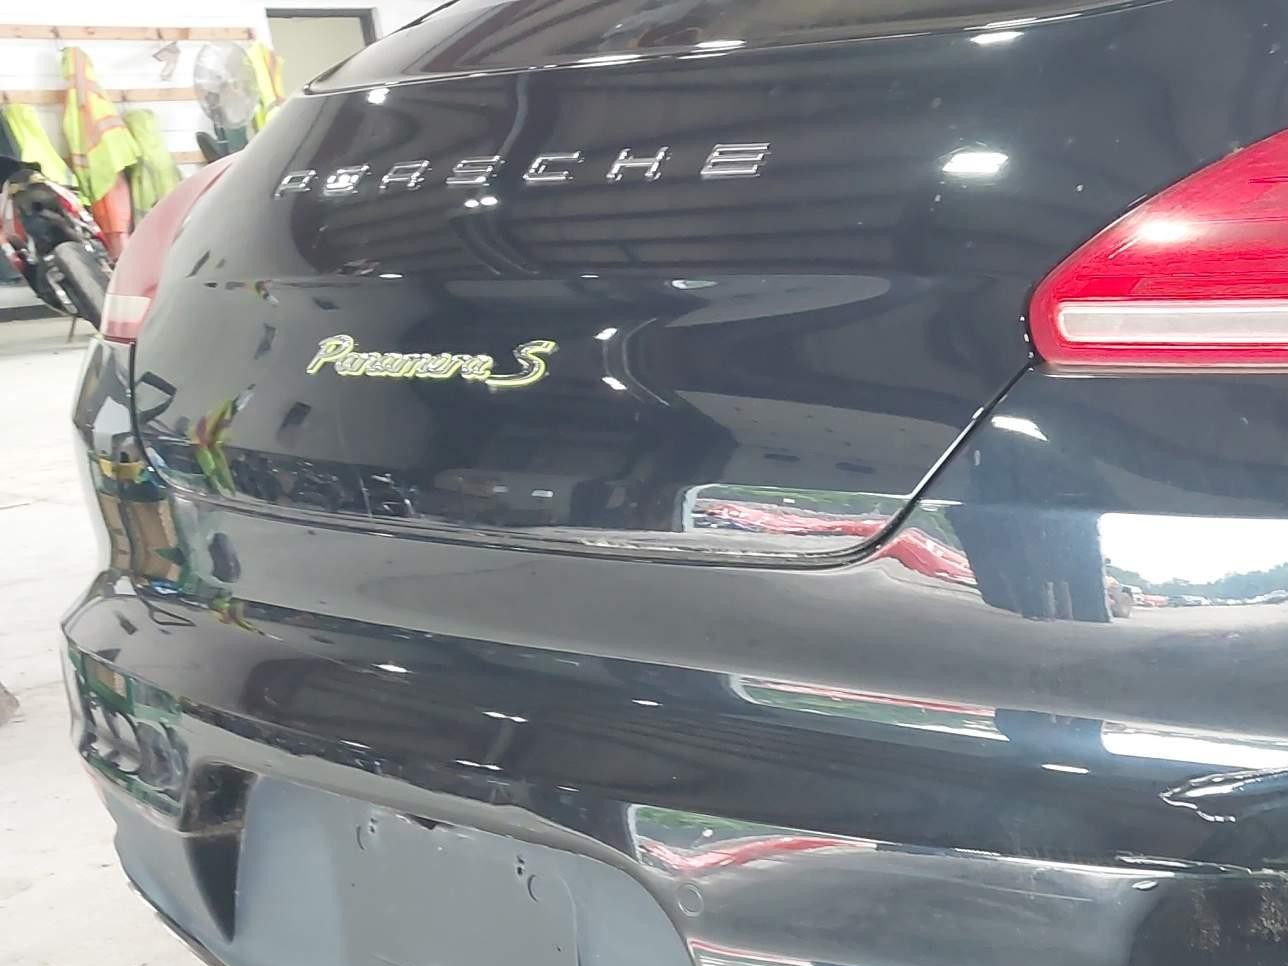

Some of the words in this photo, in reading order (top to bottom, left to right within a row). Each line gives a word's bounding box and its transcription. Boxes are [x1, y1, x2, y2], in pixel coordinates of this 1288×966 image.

[274, 142, 772, 199] PORSCHE
[305, 334, 495, 381] Panamera
[486, 340, 560, 387] S
